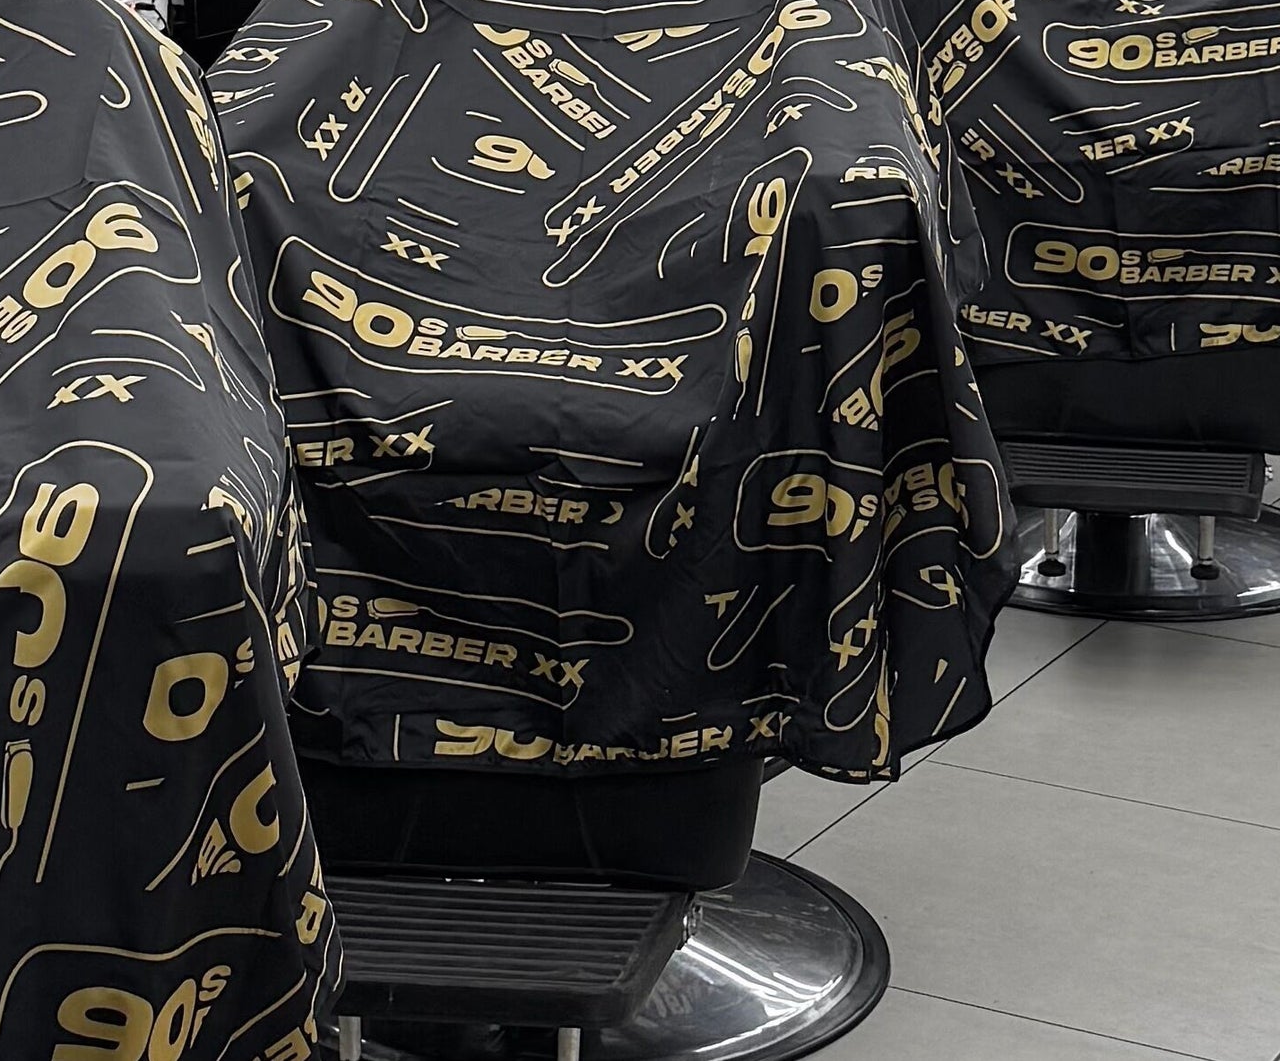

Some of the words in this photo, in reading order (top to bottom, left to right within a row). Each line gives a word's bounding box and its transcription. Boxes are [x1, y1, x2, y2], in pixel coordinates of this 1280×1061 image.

[305, 112, 349, 162] XX
[609, 67, 755, 194] BARBER
[1144, 116, 1195, 146] XX
[546, 195, 607, 248] XX
[379, 231, 451, 272] XX
[1119, 263, 1257, 284] BARBER
[406, 335, 604, 372] BARBER
[614, 353, 690, 381] XX
[1039, 320, 1092, 356] XX
[369, 423, 436, 458] XX
[325, 620, 519, 670] BARBER
[528, 652, 591, 689] XX
